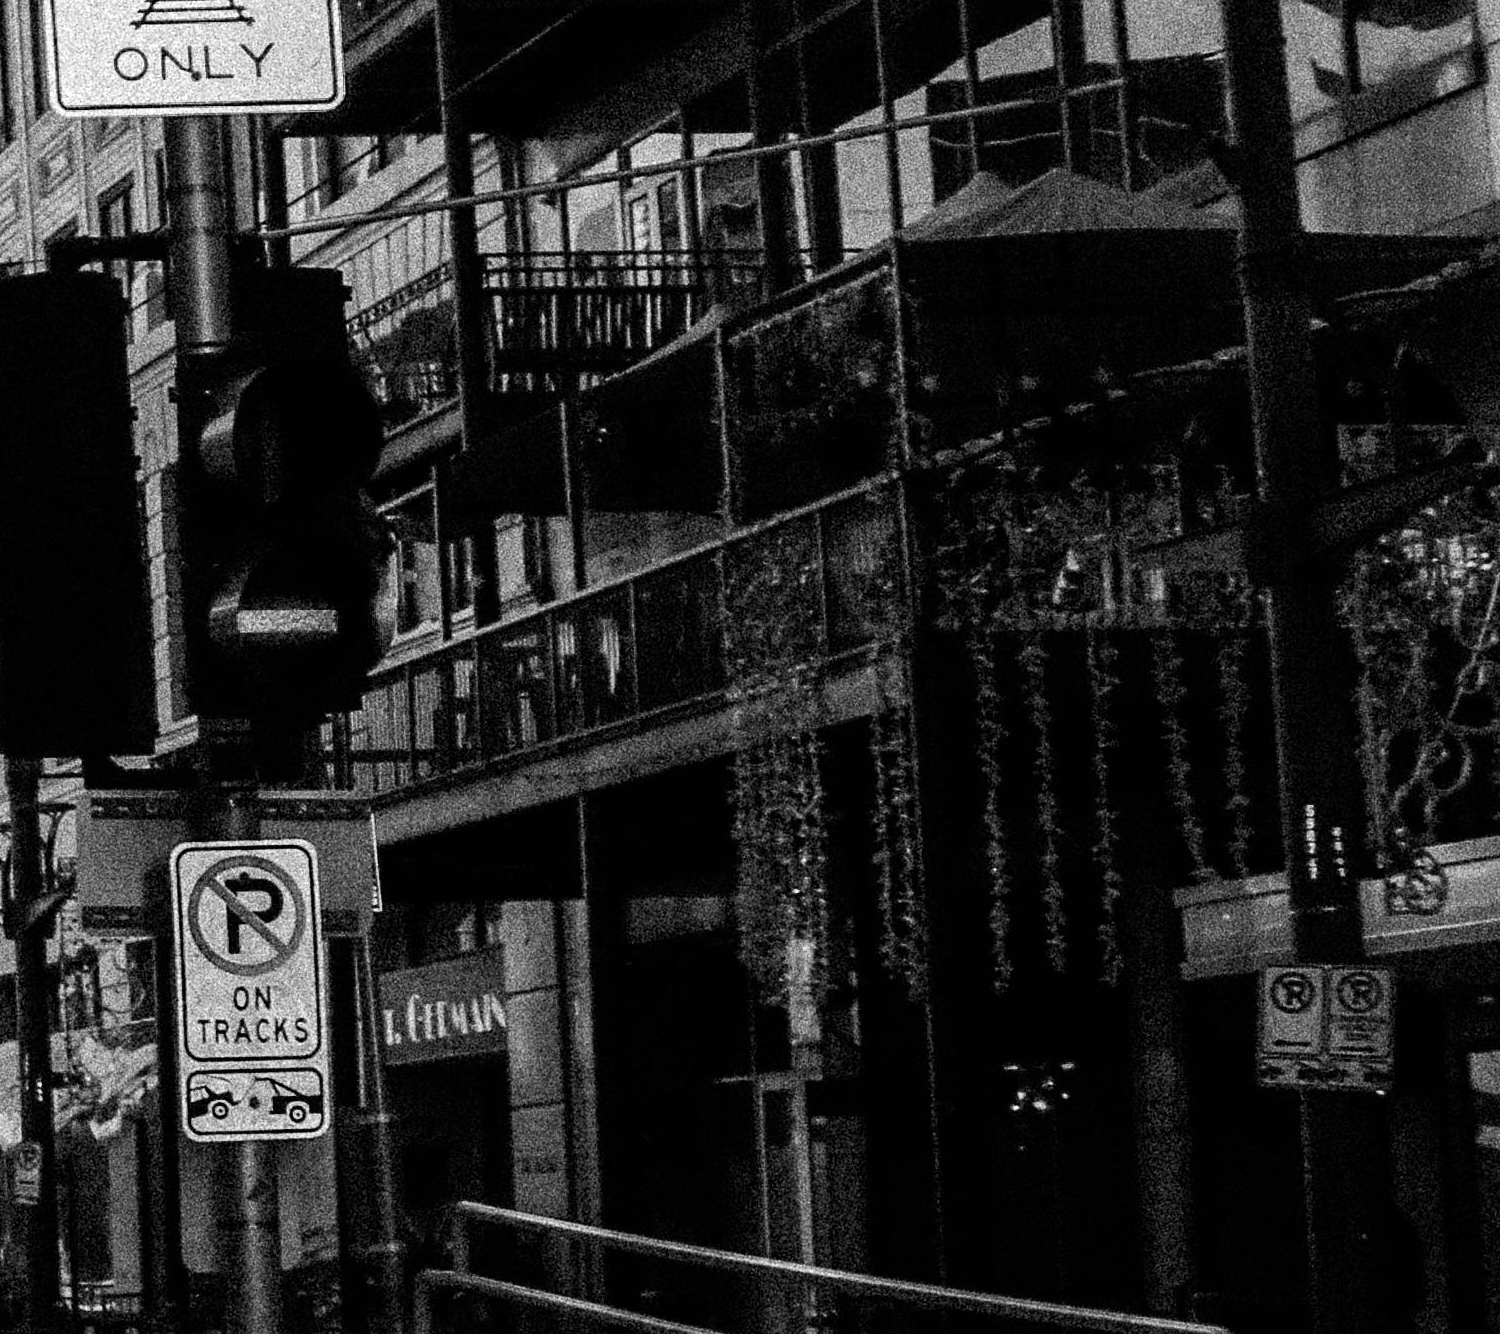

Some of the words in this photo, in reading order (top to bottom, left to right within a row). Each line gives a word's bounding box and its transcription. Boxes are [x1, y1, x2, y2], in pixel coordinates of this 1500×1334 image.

[113, 42, 275, 82] ONLY
[232, 986, 272, 1010] ON
[198, 1017, 310, 1045] TRACKS
